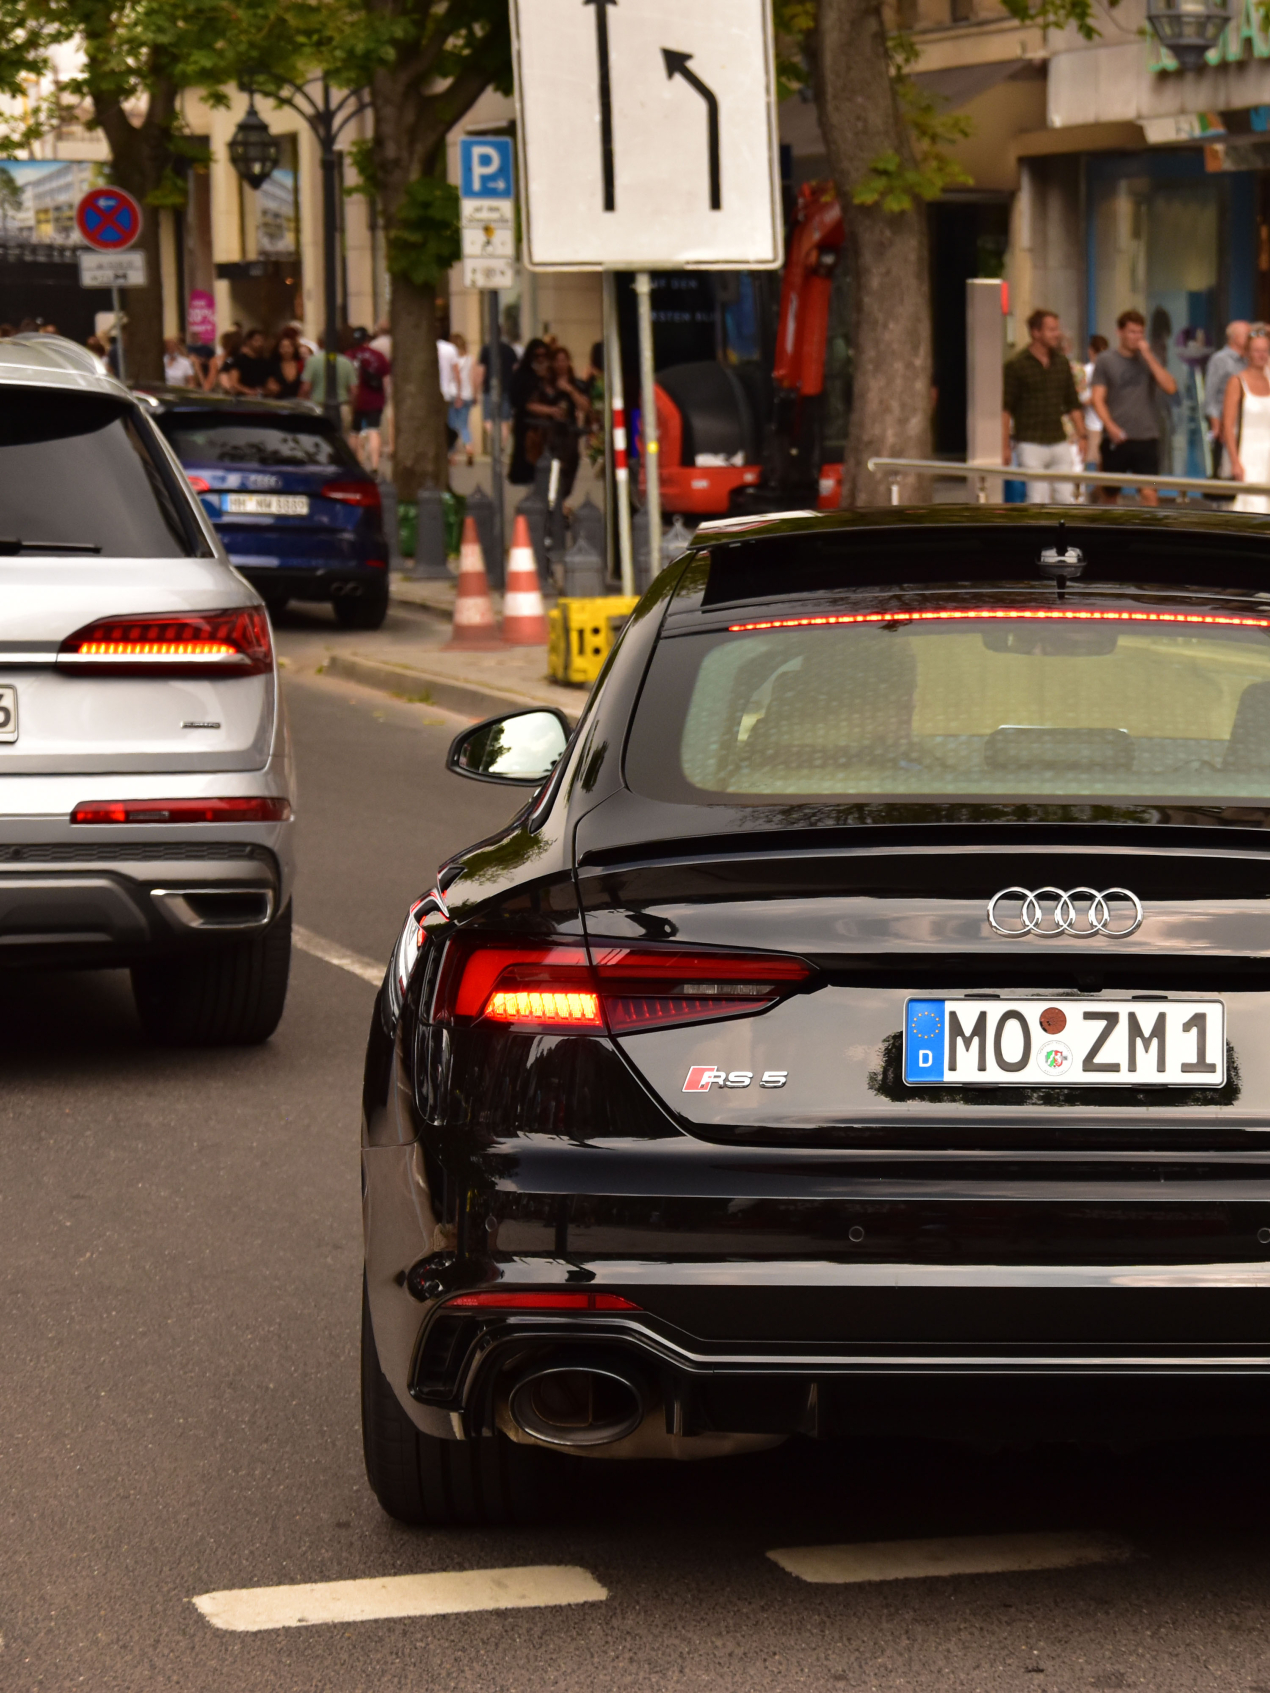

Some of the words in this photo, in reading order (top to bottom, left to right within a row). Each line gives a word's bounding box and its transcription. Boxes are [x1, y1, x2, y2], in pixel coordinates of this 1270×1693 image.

[472, 146, 500, 192] P
[948, 1009, 1032, 1072] MO
[1082, 1011, 1166, 1072] ZM
[1180, 1012, 1217, 1073] 1
[918, 1050, 933, 1067] D
[698, 1071, 754, 1088] RS
[760, 1071, 788, 1088] 5
